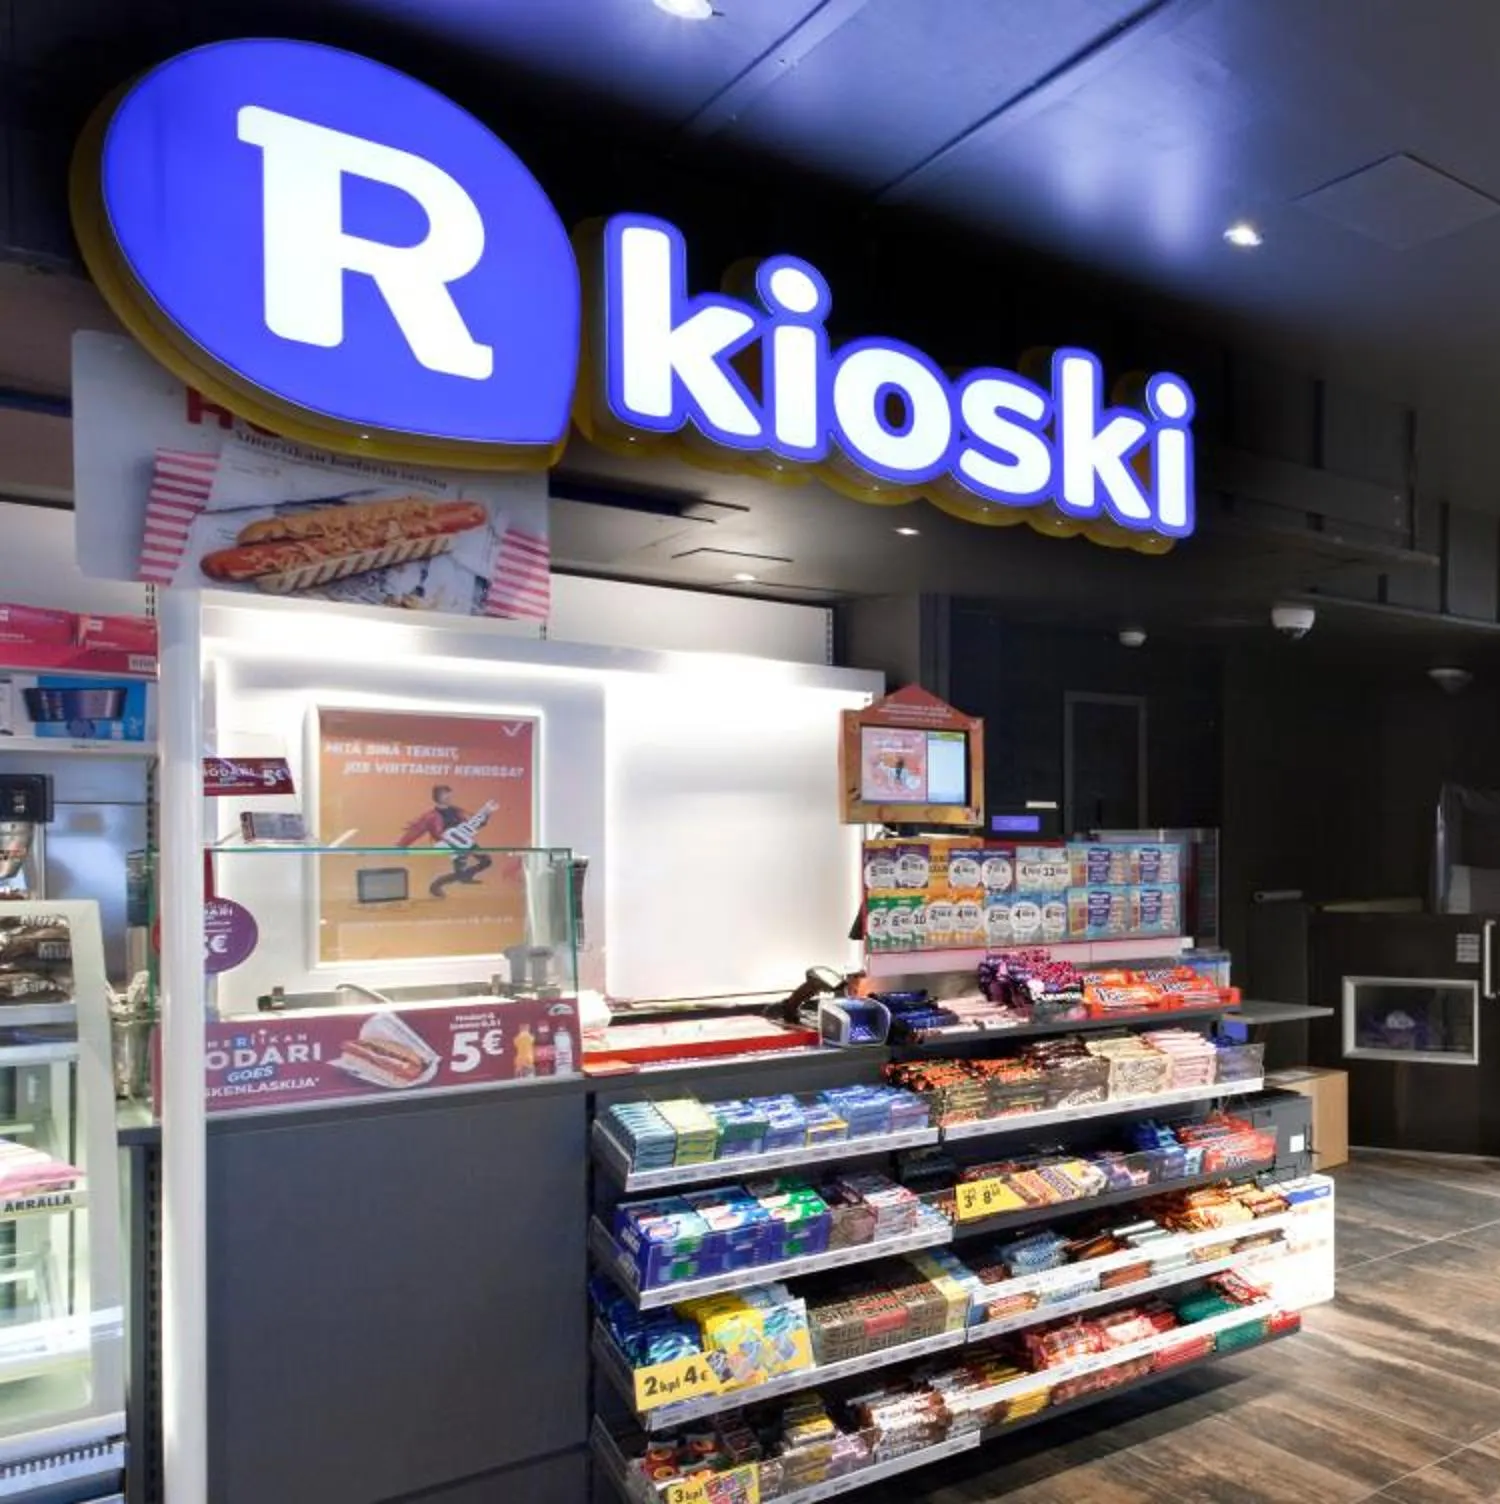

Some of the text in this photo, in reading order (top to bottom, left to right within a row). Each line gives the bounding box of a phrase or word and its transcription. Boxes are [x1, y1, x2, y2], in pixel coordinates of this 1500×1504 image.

[237, 105, 1191, 529] R kioski
[450, 1028, 504, 1073] 5€
[227, 1065, 274, 1082] GOES
[644, 1375, 658, 1396] 2
